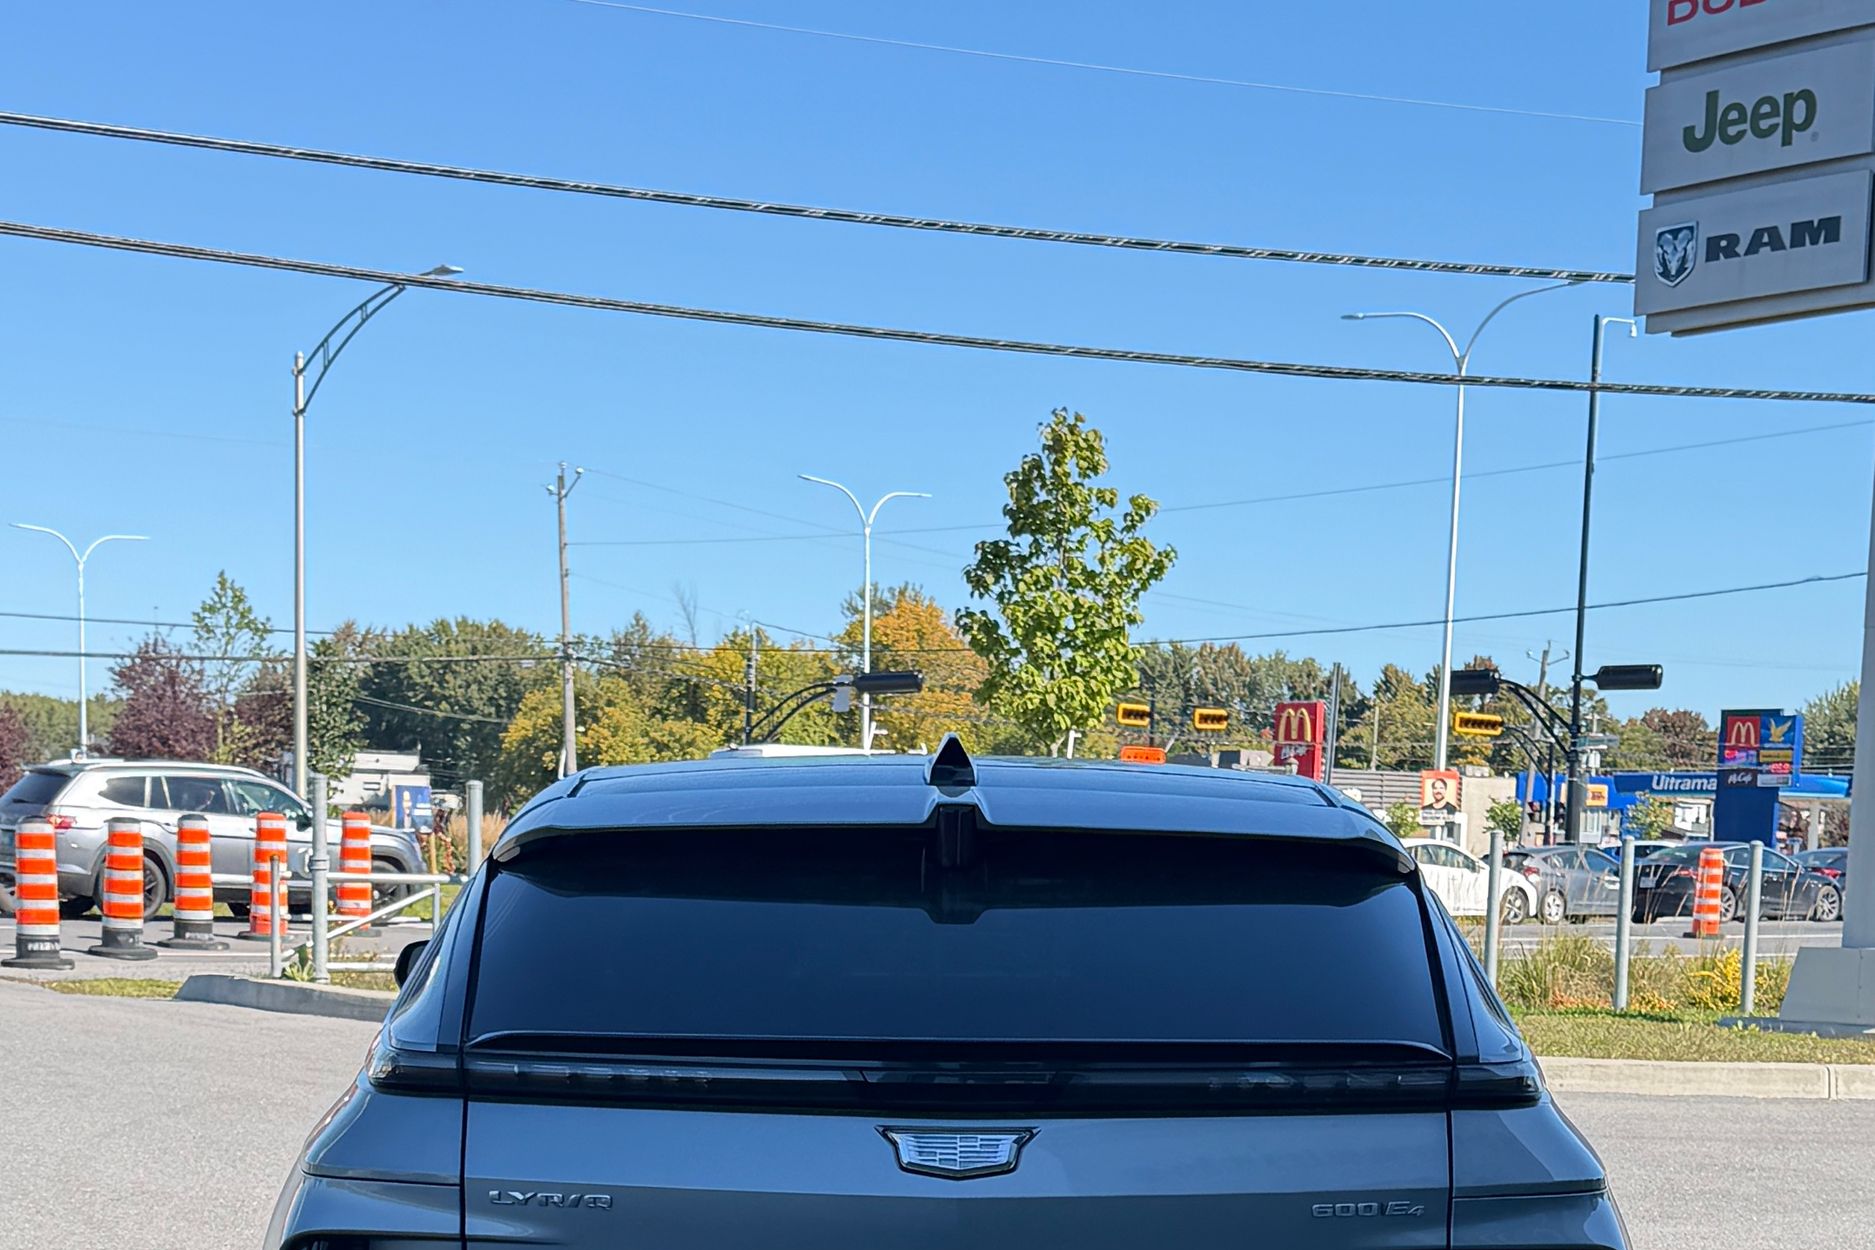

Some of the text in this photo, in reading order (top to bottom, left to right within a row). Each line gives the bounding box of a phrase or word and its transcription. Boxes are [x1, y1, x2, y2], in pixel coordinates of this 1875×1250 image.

[1682, 88, 1818, 153] Jeep
[1704, 215, 1842, 263] RAM
[1651, 774, 1718, 791] Ultrama
[488, 1189, 613, 1211] LYRIQ
